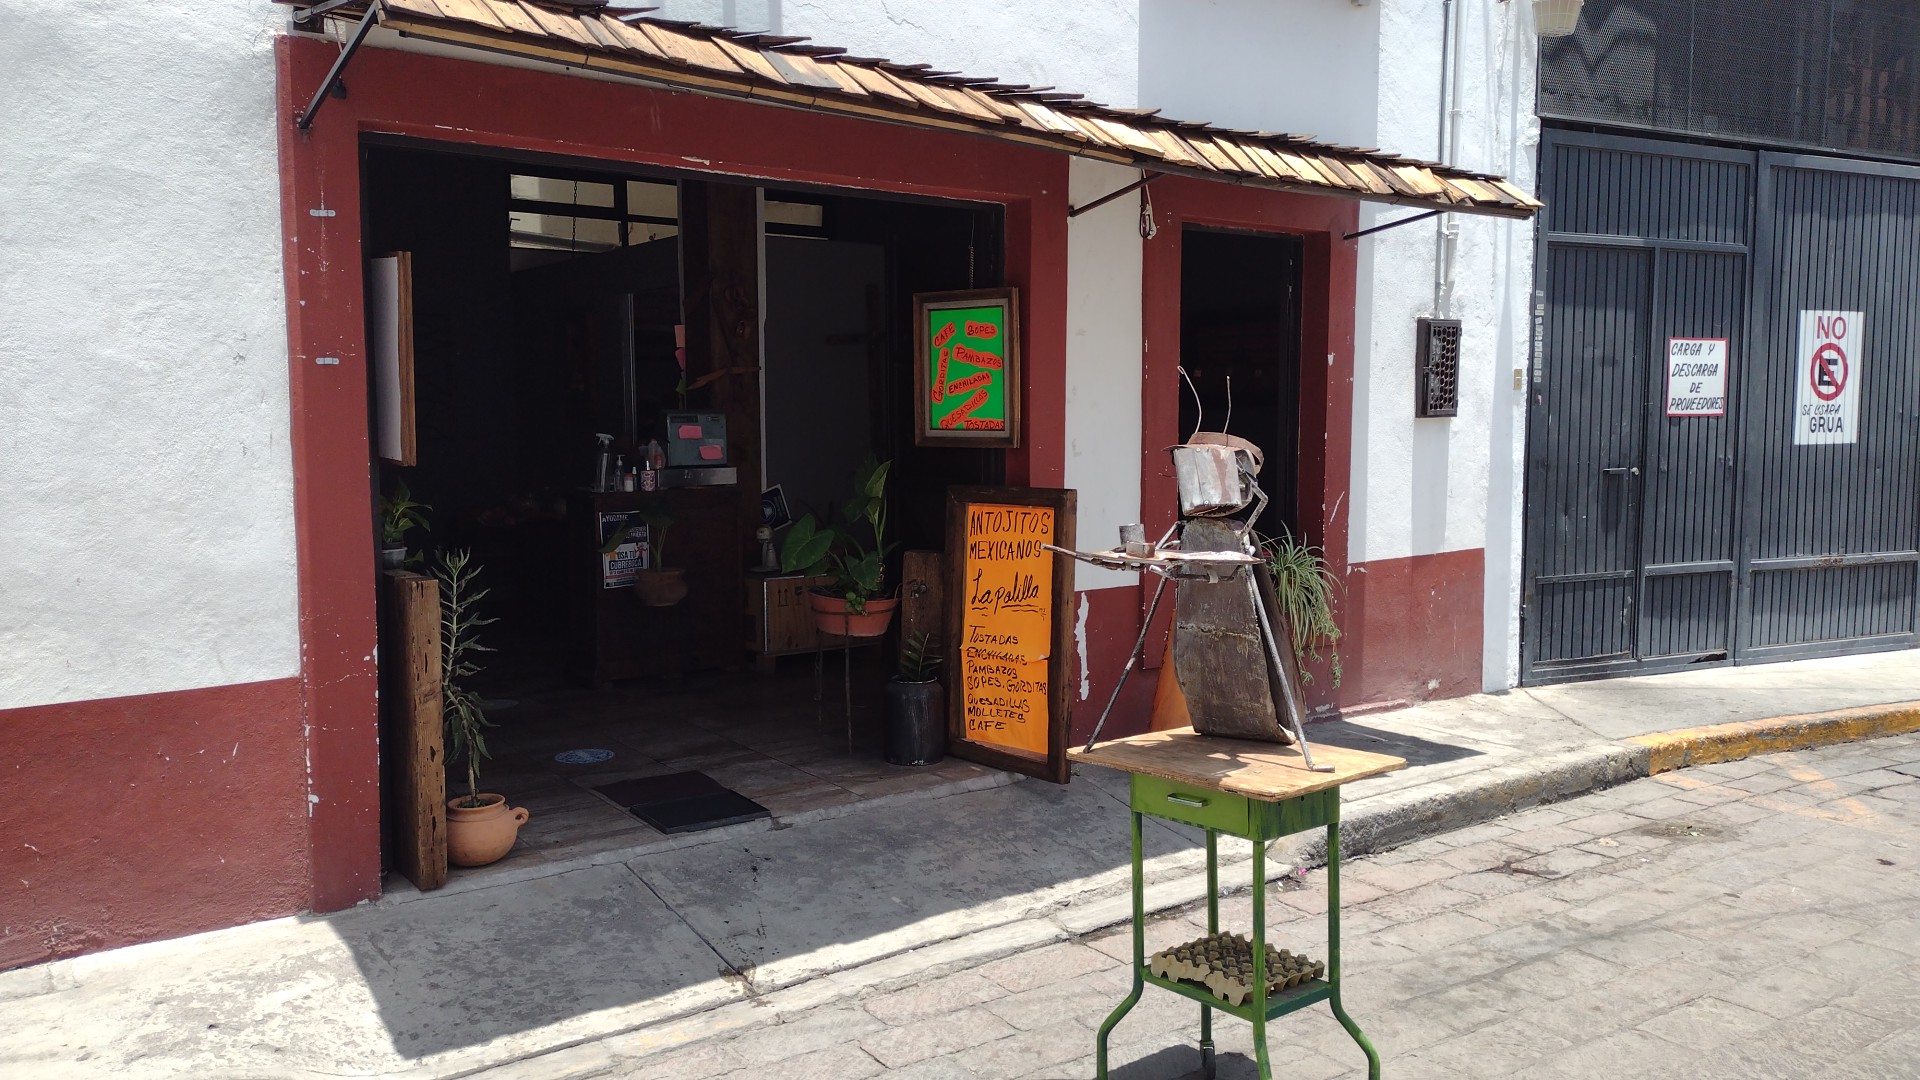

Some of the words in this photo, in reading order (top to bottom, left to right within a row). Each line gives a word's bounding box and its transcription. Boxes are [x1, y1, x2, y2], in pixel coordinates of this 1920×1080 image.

[934, 323, 955, 347] CAFE
[967, 325, 996, 336] SOPES
[1817, 316, 1847, 339] NO
[956, 346, 1002, 368] PAMBAZOS
[1671, 343, 1702, 356] CARGA
[1708, 344, 1715, 356] Y
[932, 350, 949, 402] GORDITAS
[1672, 363, 1719, 377] DESCARGA
[949, 372, 990, 394] ENCHILADAS
[1689, 382, 1703, 393] DE
[940, 389, 988, 429] QUESADILLAS
[1669, 397, 1724, 411] PROVEEDORES
[1802, 404, 1813, 416] SE
[1814, 403, 1841, 416] USARA
[963, 419, 1005, 430] TOSTADAS
[1810, 416, 1843, 433] GRUA
[970, 510, 1051, 537] ANTOJITOS
[969, 539, 1042, 561] MEXICANOS
[969, 624, 1019, 645] TOSTADAS
[966, 646, 1028, 666] ENCHILADAS
[966, 660, 1018, 679] PAMBAZOS
[1006, 679, 1047, 696] GORDITAS
[967, 705, 1026, 724] MOLLETES
[969, 718, 1007, 732] CAFE
